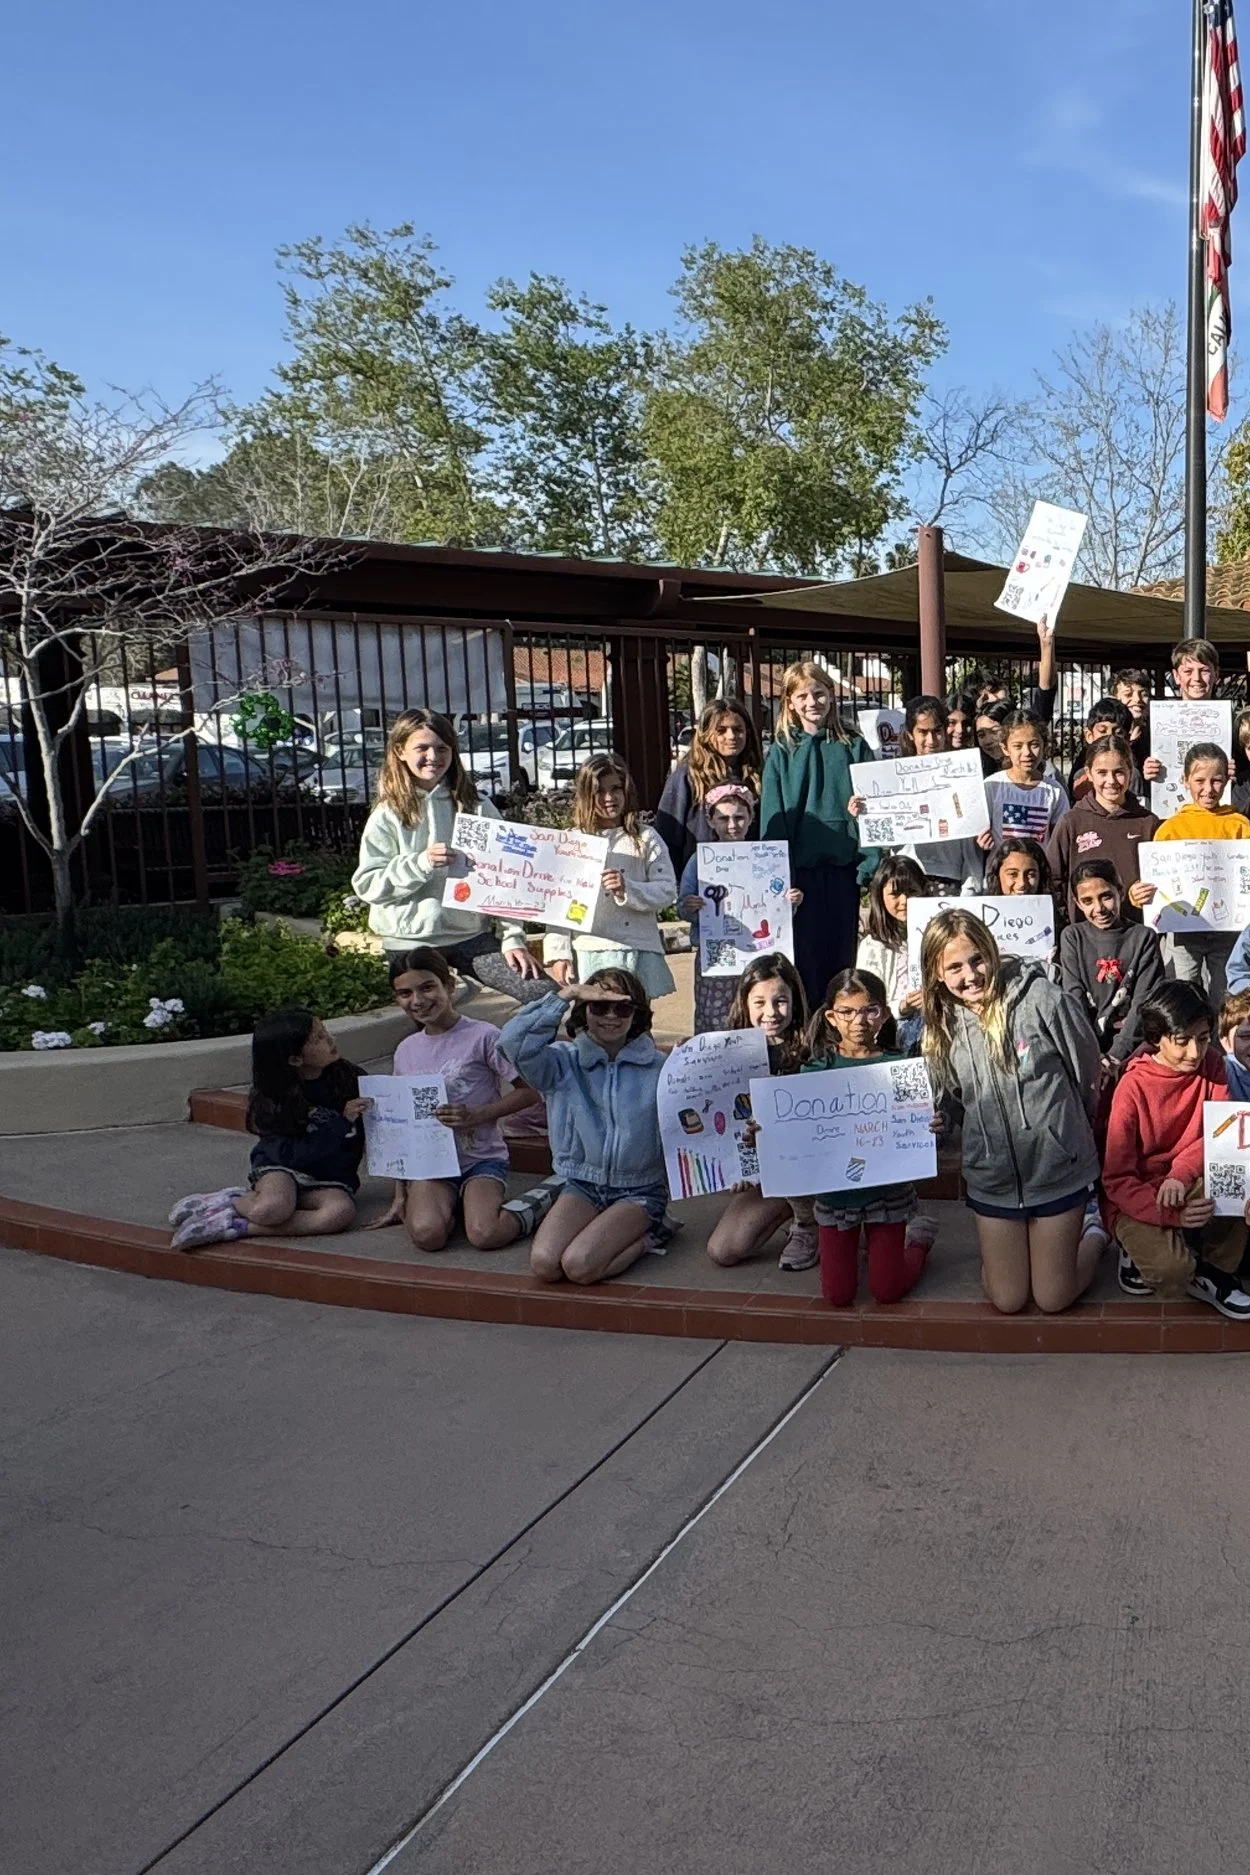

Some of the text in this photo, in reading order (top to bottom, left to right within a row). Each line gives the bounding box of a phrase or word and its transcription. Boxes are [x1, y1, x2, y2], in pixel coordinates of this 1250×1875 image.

[529, 828, 555, 842] San
[477, 872, 517, 889] School
[982, 903, 1034, 929] Diego
[774, 1081, 888, 1118] Donation
